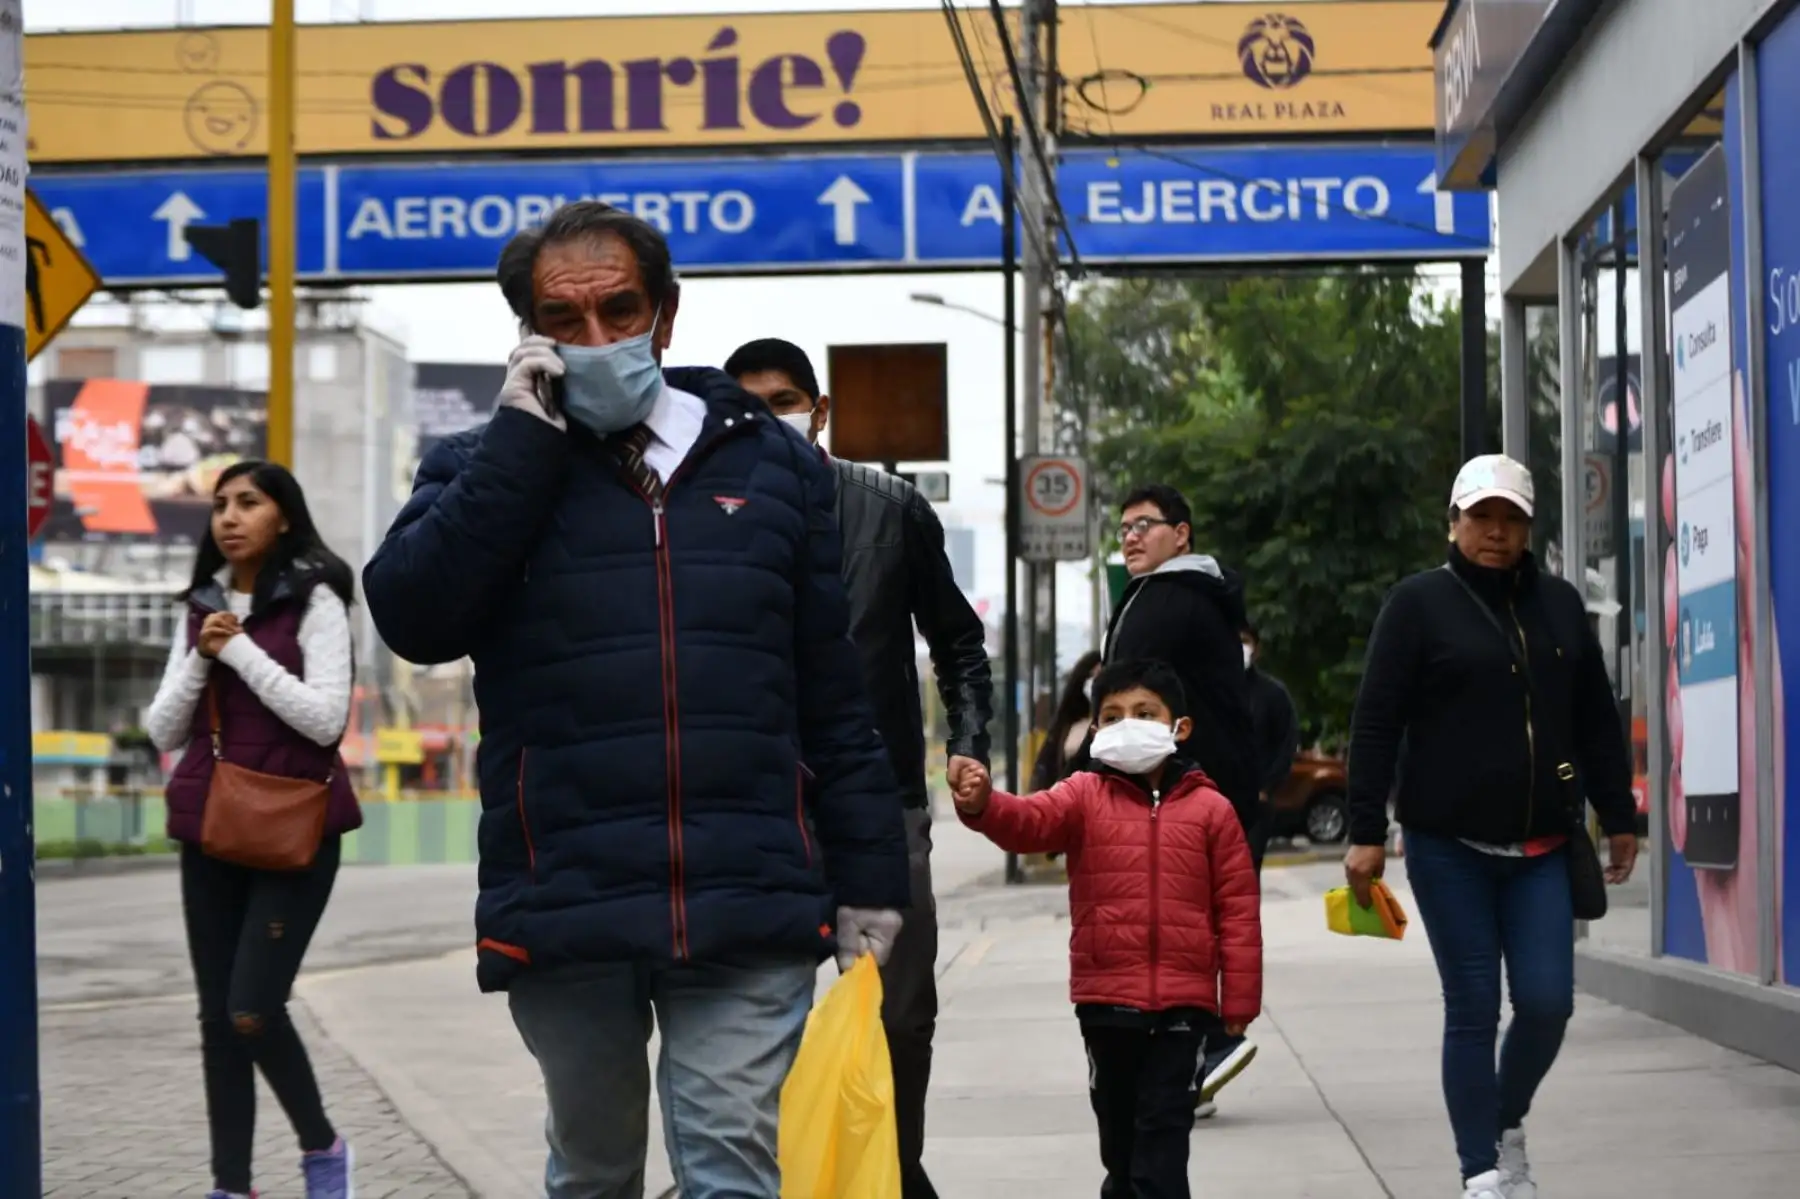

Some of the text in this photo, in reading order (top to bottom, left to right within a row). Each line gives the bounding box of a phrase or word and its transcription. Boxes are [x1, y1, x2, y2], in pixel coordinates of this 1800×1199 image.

[371, 27, 866, 140] sonríe!
[1445, 0, 1480, 133] BBVA
[1210, 101, 1346, 120] REAL PLAZA
[347, 191, 755, 239] AEROPRTO
[1087, 176, 1389, 223] EJERCITO
[1689, 320, 1716, 359] Consulta
[1691, 419, 1722, 454] Transfiere
[1037, 474, 1069, 495] 35
